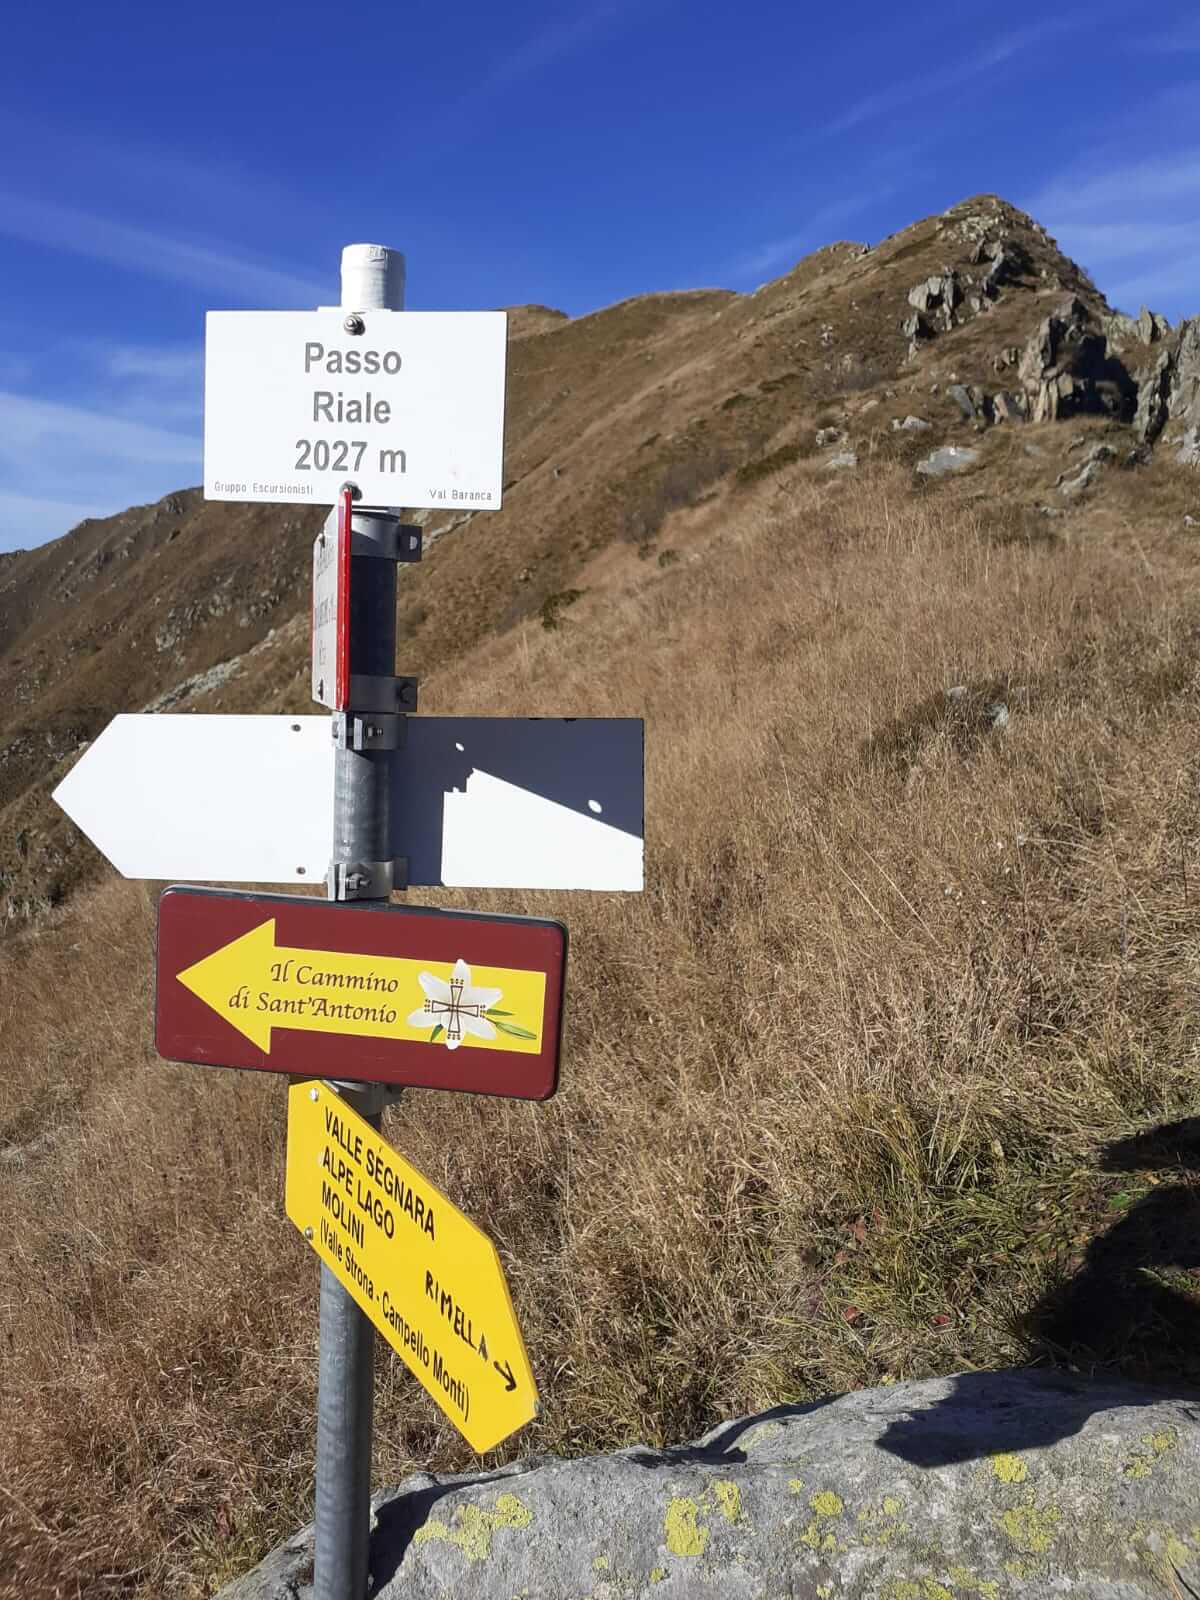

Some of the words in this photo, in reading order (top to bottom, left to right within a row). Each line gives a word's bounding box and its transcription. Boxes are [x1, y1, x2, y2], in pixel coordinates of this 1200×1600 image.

[304, 342, 402, 375] Passo
[313, 391, 391, 424] Riale
[295, 439, 368, 472] 2027
[379, 449, 406, 473] m
[214, 481, 247, 494] Gruppo
[253, 482, 313, 495] Escursionisti
[429, 488, 447, 500] Val
[452, 489, 492, 501] Baranca
[270, 960, 294, 983] Il
[296, 964, 399, 993] Cammino
[228, 985, 250, 1009] di
[256, 991, 397, 1024] Sant'Antonio
[324, 1106, 362, 1166] VALLE
[322, 1146, 354, 1197] ALPE
[357, 1180, 395, 1239] LAGO
[322, 1181, 364, 1249] MOLINI
[320, 1216, 343, 1262] (Valle
[345, 1247, 374, 1301] Strona
[382, 1291, 430, 1368] Campello
[432, 1351, 470, 1423] Monti)
[425, 1270, 489, 1361] RIMELLA
